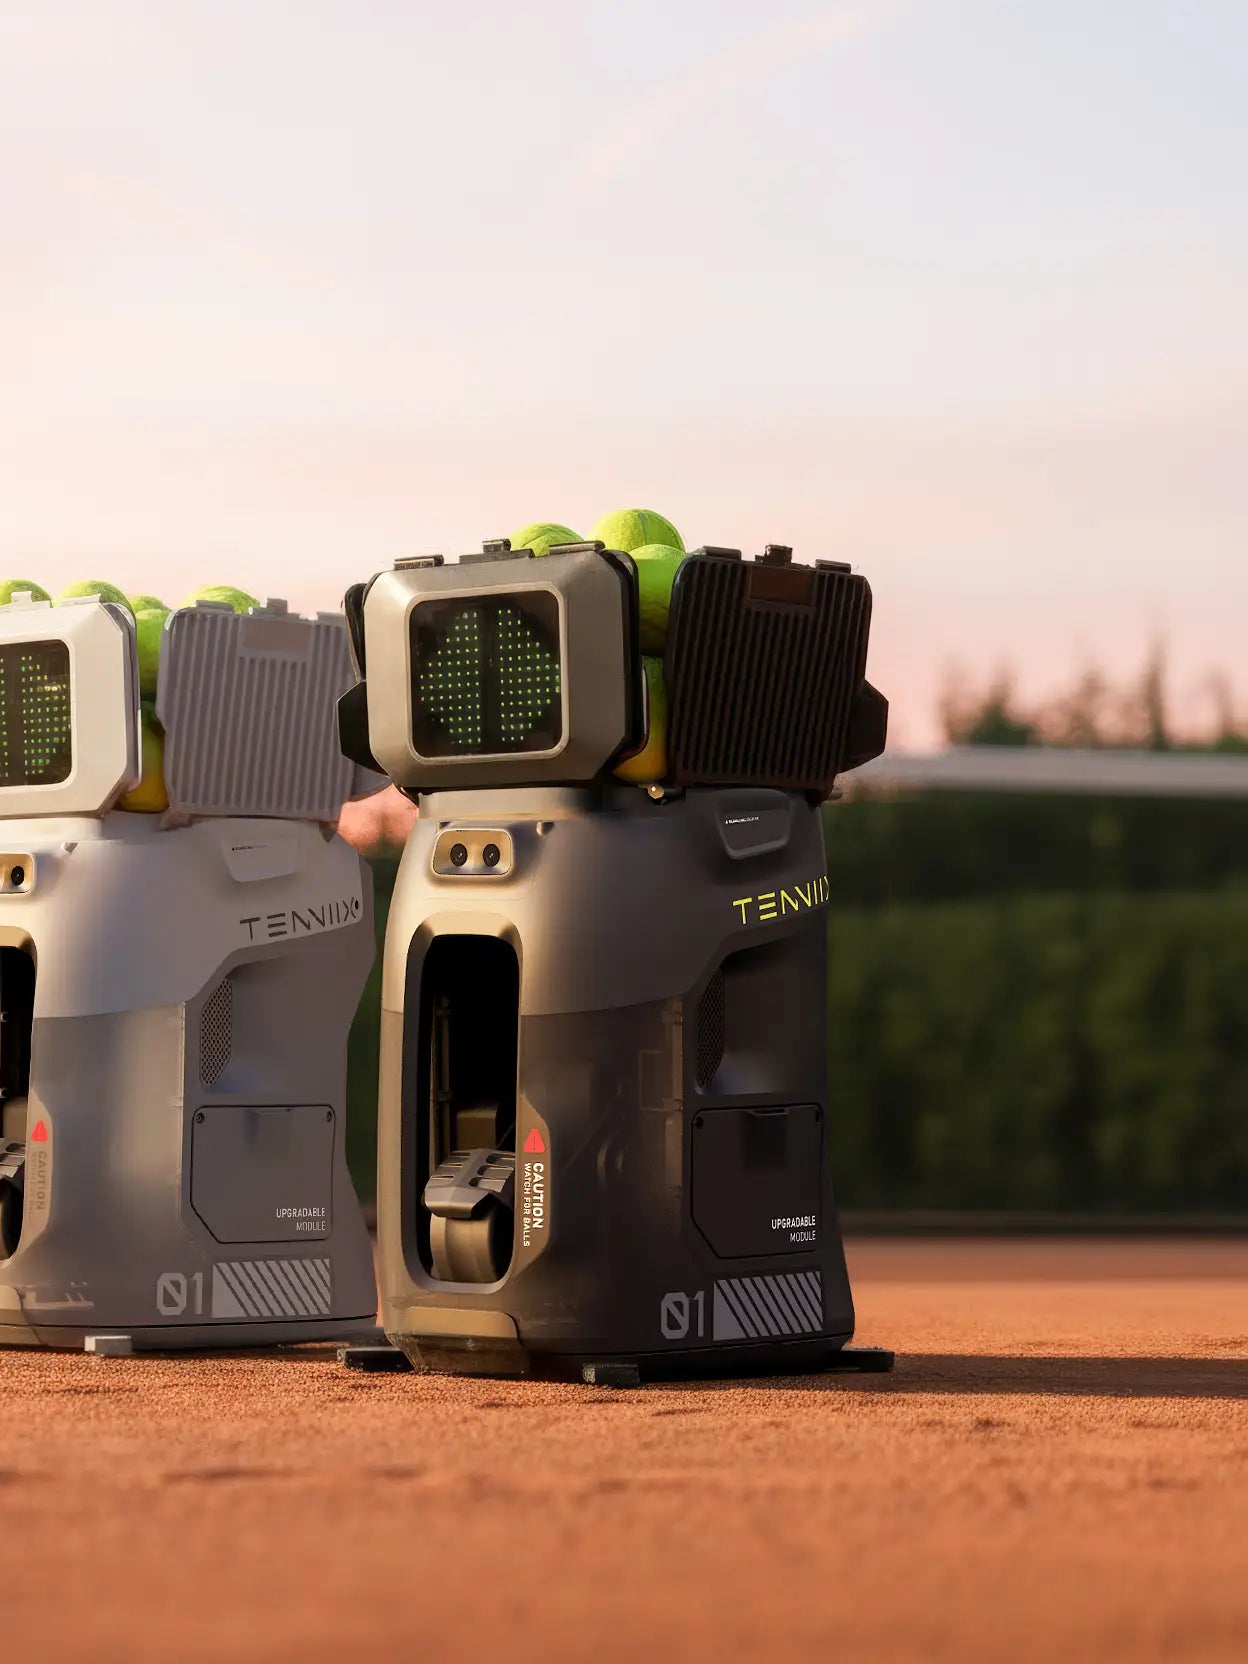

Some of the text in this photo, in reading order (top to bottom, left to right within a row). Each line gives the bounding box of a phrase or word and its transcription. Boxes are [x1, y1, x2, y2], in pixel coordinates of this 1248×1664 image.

[36, 1150, 48, 1211] CAUTION
[532, 1162, 545, 1229] CAUTION
[523, 1162, 532, 1247] WATCH FOR BALLS
[276, 1207, 326, 1219] UPGRADABLE
[295, 1220, 326, 1232] MODULE
[771, 1215, 816, 1230] UPGRADABLE
[789, 1229, 817, 1243] MODULE
